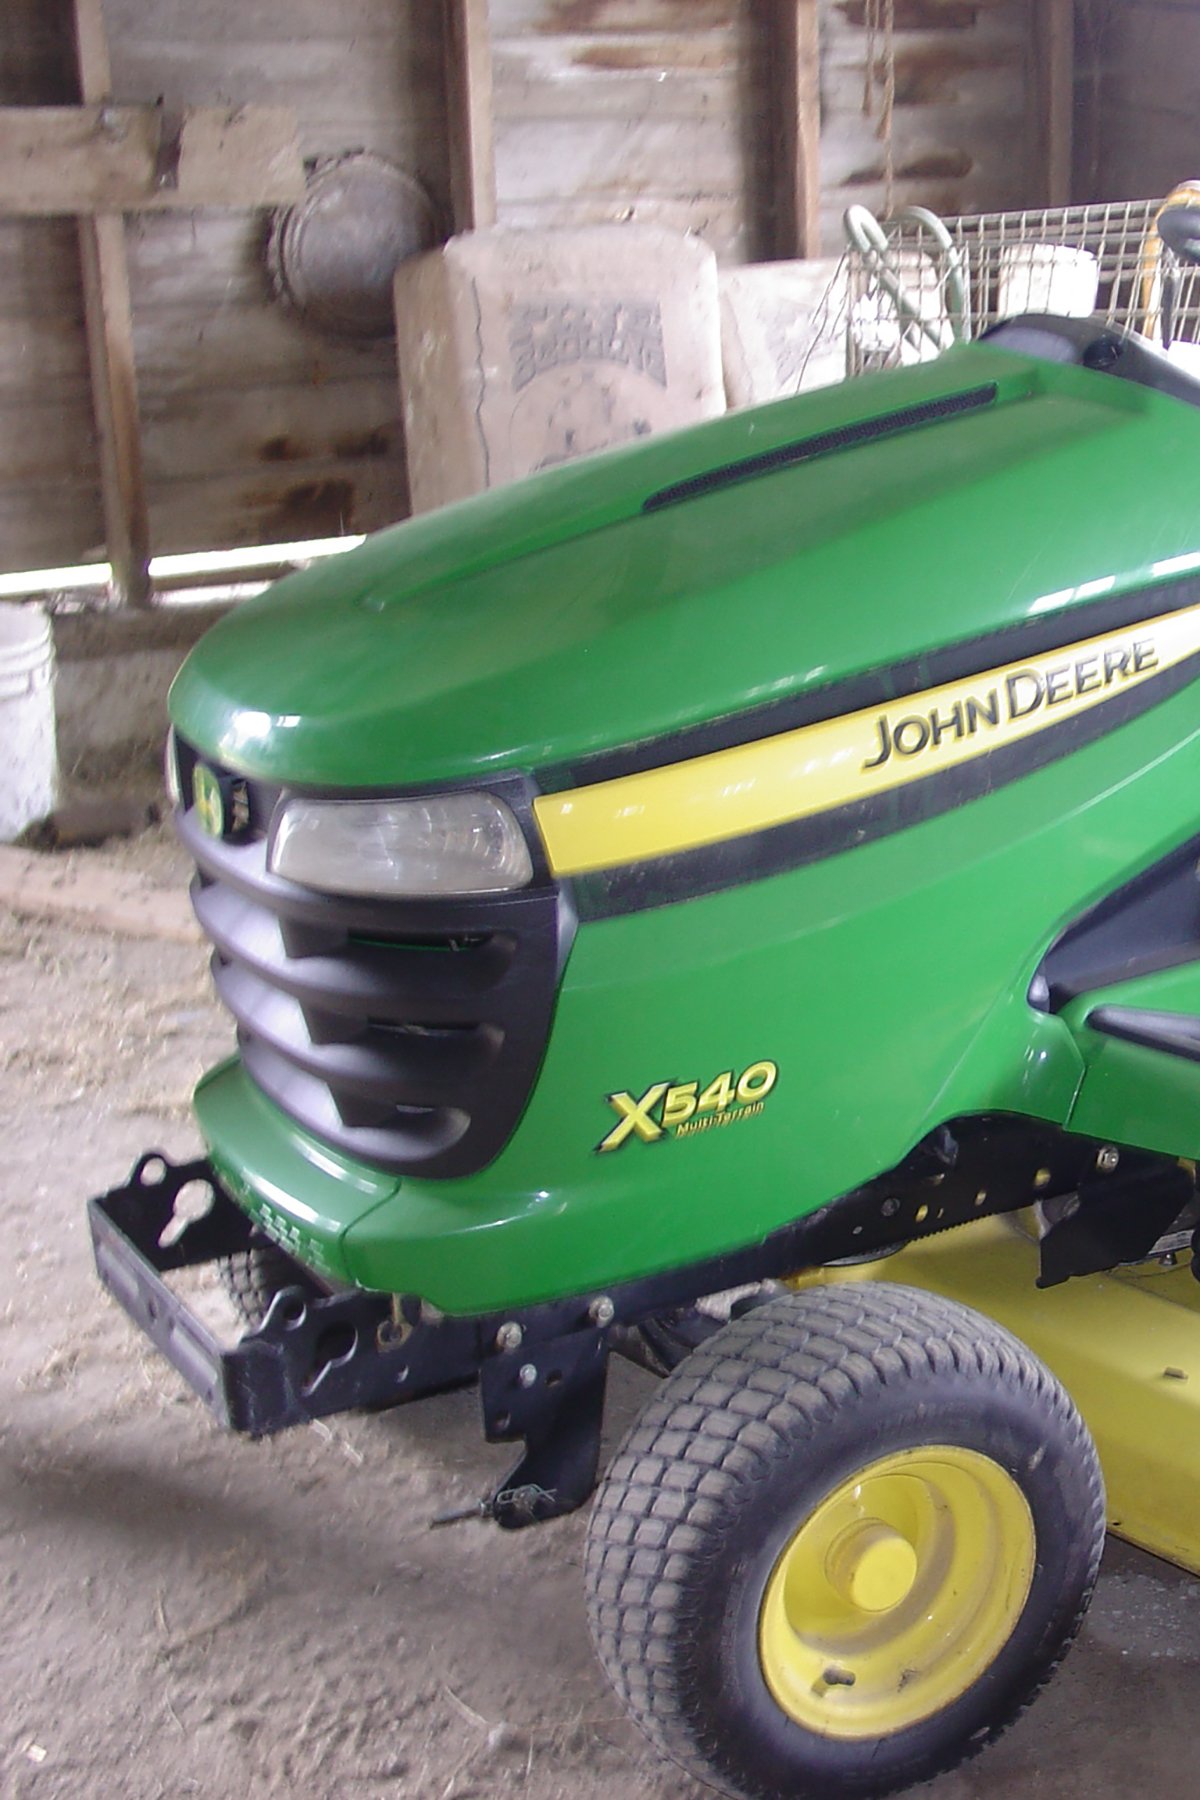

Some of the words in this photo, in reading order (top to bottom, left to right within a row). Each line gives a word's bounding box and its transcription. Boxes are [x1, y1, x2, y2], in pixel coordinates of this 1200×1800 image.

[863, 689, 999, 769] JOHN
[1005, 638, 1160, 718] DEERE
[597, 1060, 777, 1153] X540
